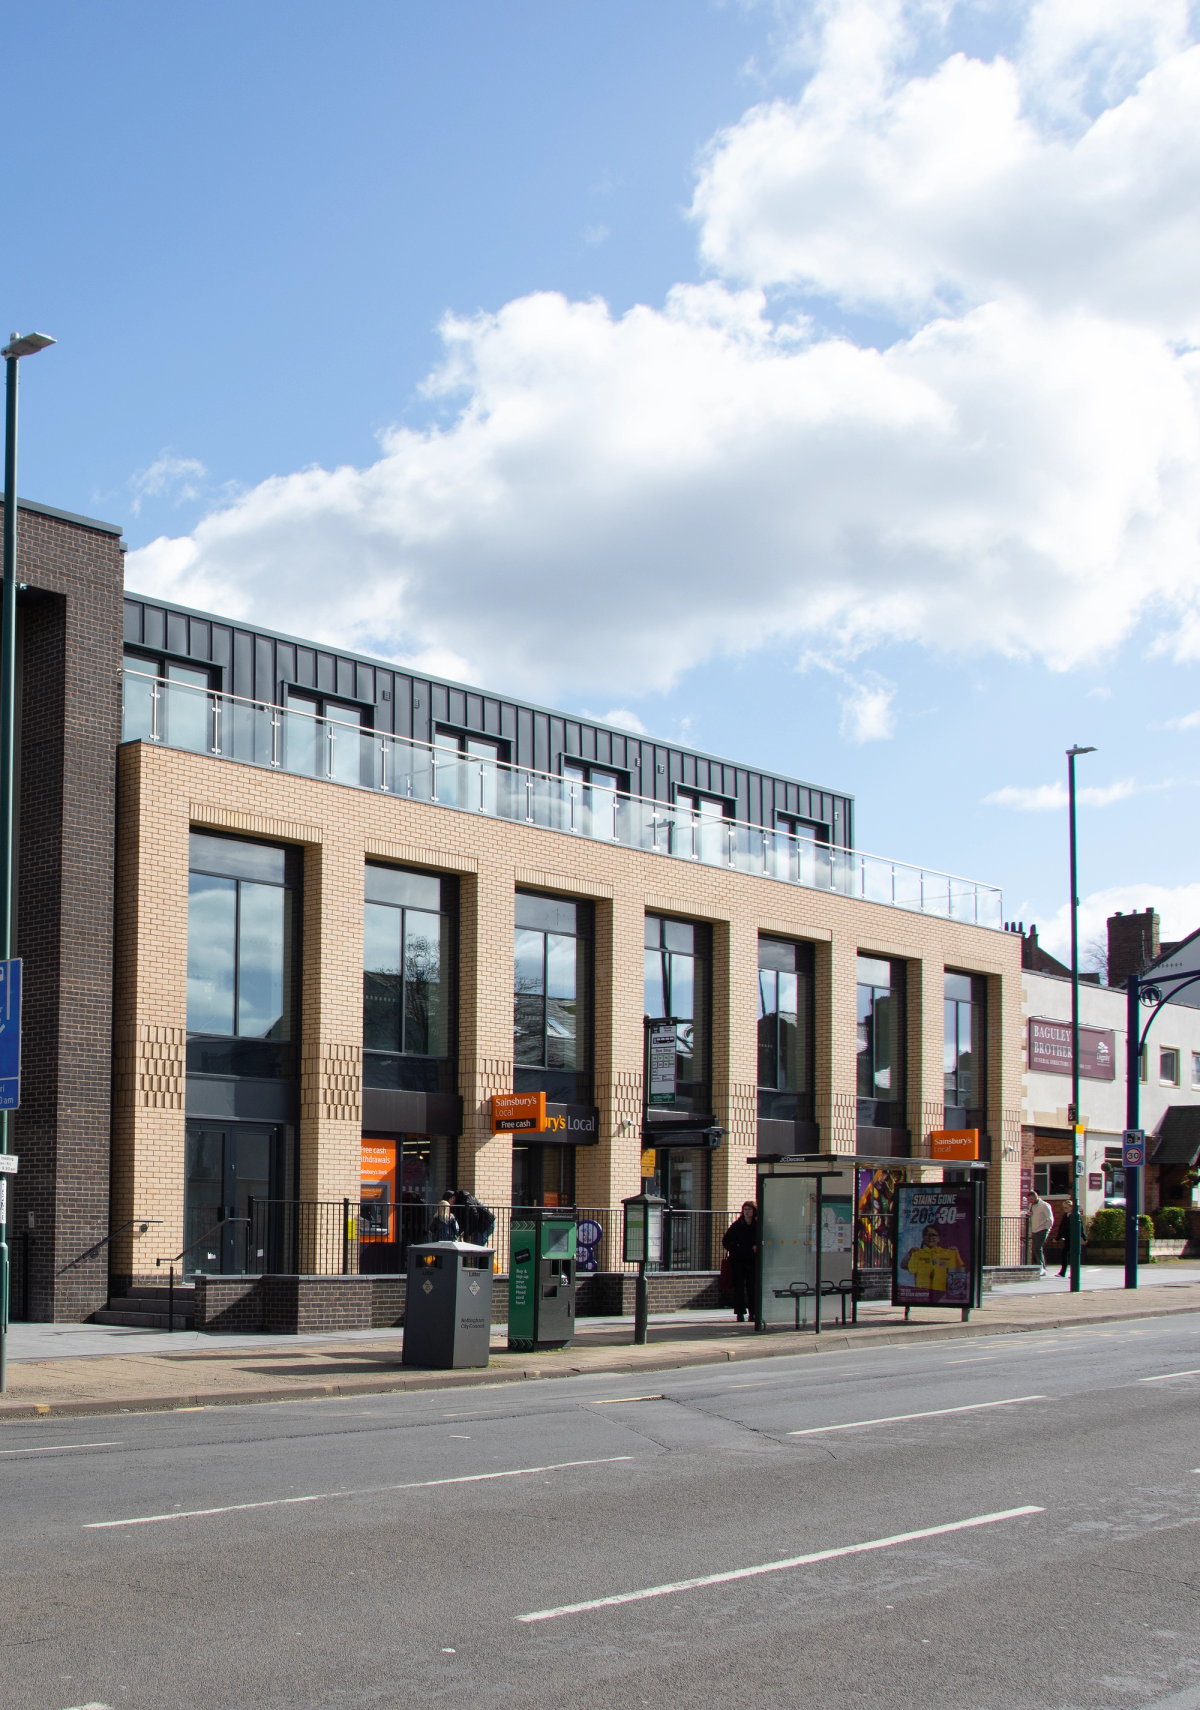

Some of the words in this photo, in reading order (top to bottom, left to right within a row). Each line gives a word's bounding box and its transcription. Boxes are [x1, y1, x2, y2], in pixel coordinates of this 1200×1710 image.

[1034, 1025, 1072, 1042] BAGULEY
[1034, 1041, 1073, 1058] BROTHER
[3, 1097, 14, 1105] am
[495, 1095, 537, 1107] Sainsbury's
[495, 1108, 514, 1117] Local
[501, 1120, 515, 1129] Free
[516, 1119, 531, 1128] cash
[568, 1115, 595, 1132] Local
[934, 1137, 973, 1146] Sainsbury's
[373, 1146, 387, 1154] cash
[361, 1155, 391, 1164] ithdrawals
[1127, 1152, 1140, 1160] 30
[913, 1194, 937, 1205] STAINS
[938, 1193, 957, 1204] GONE
[938, 1206, 957, 1224] 30
